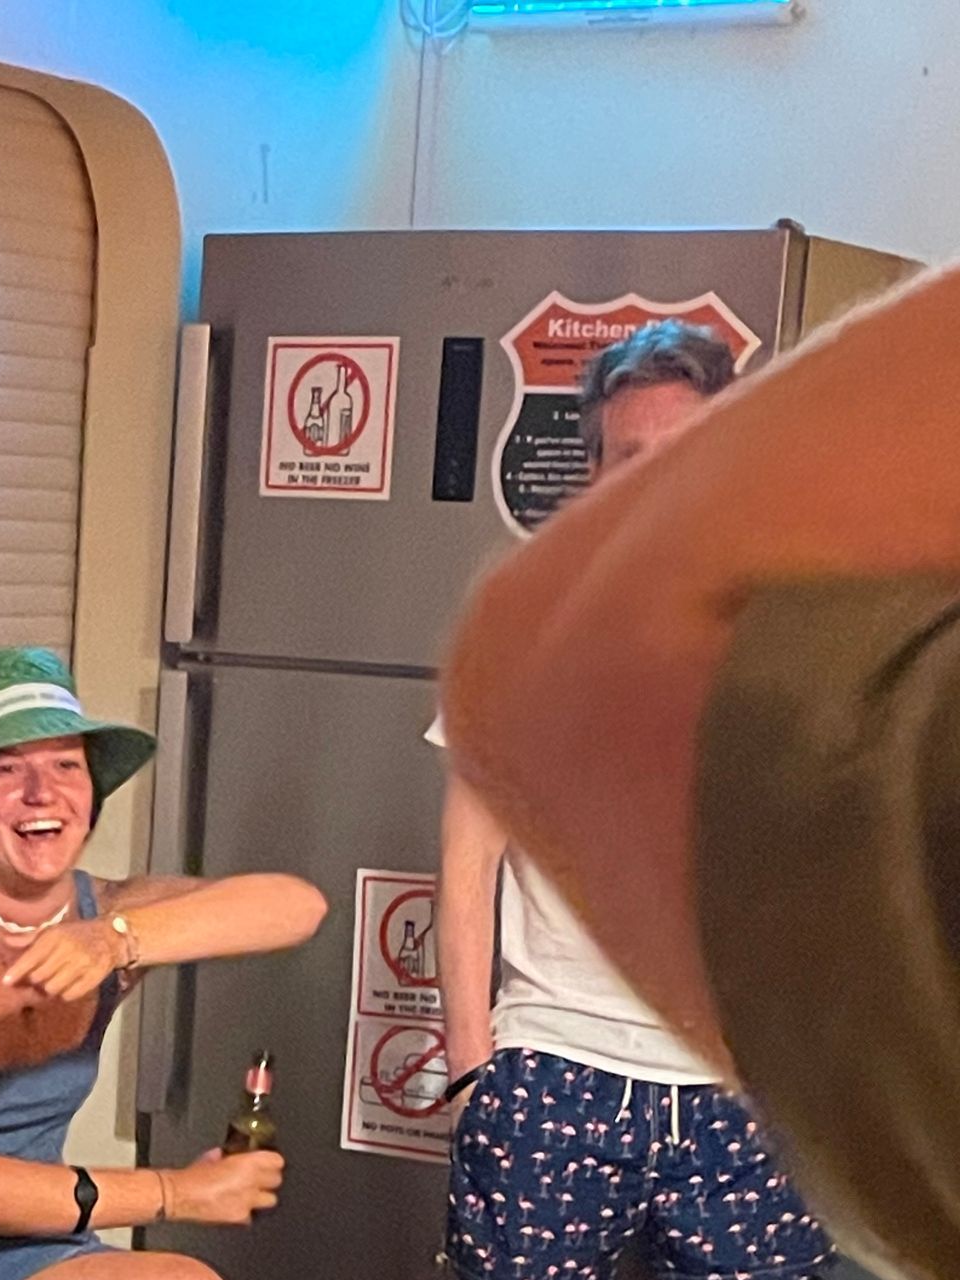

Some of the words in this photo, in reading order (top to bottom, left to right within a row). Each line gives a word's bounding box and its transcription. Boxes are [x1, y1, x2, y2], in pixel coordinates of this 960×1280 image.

[547, 318, 636, 339] Kitchen
[279, 462, 297, 472] NO
[299, 462, 321, 472] BEER
[324, 463, 341, 472] NO
[344, 463, 370, 473] WINE
[373, 990, 390, 1000] NO
[420, 992, 438, 1004] NO
[362, 1121, 378, 1131] NO
